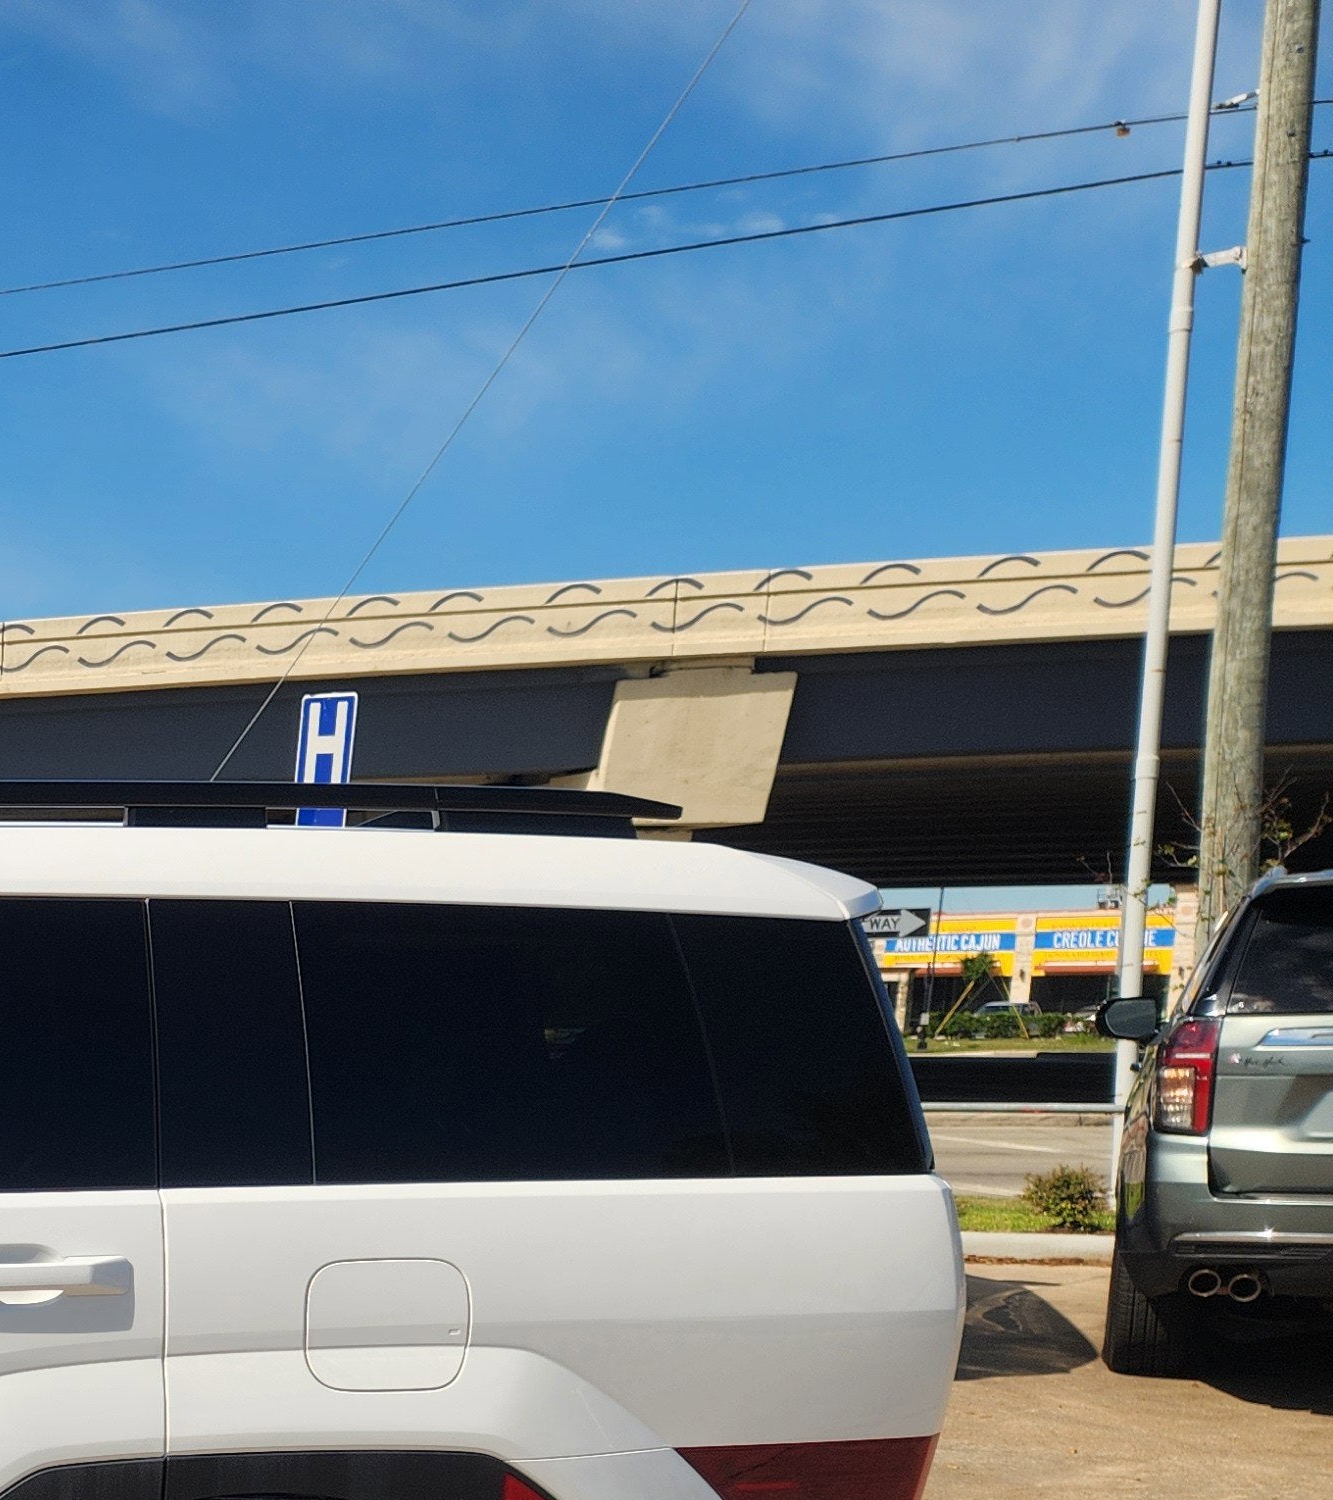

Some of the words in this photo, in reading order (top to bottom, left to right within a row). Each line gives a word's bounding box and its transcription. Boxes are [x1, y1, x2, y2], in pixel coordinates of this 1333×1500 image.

[304, 700, 349, 784] H
[869, 917, 901, 930] WAY
[894, 933, 959, 951] AUTHENTIC
[960, 933, 1001, 950] CAJUN
[1052, 929, 1104, 948] CREOLE
